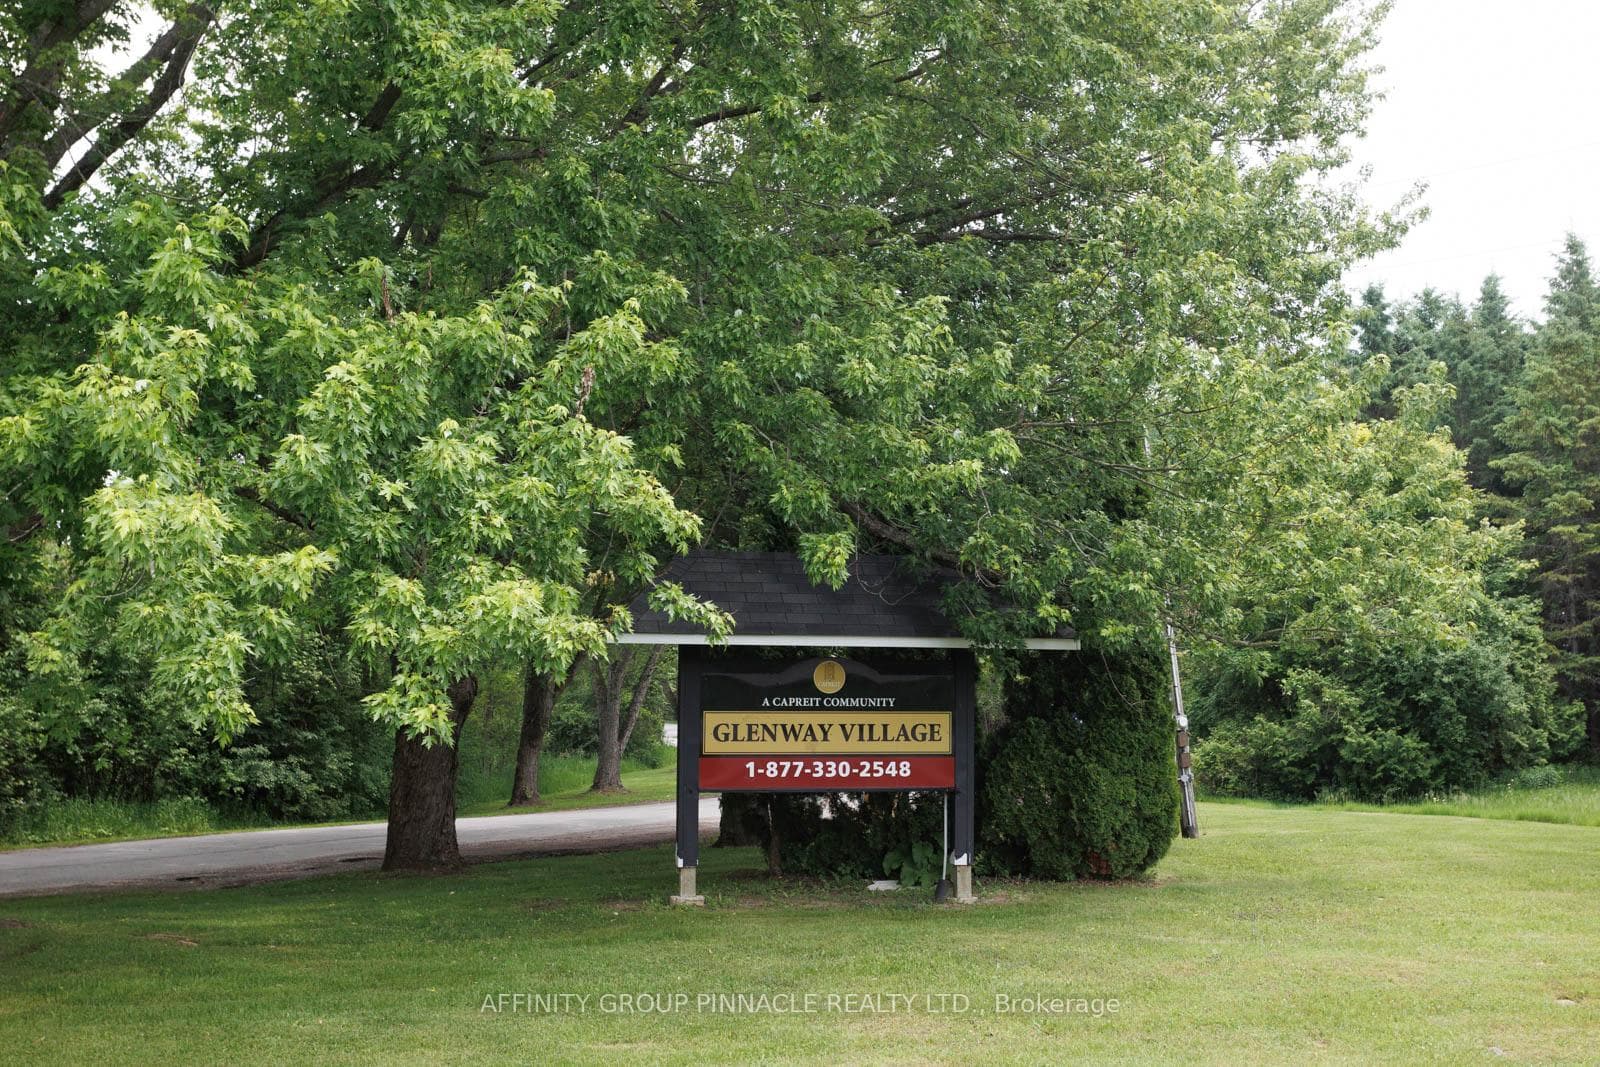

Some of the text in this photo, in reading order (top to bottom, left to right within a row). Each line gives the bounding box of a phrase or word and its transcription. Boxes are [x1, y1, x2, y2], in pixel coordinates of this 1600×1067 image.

[762, 697, 896, 707] A CAPREIT COMMUNITY
[712, 723, 942, 743] GLENWAY VILLAGE
[745, 761, 912, 778] 1-877-330-2548
